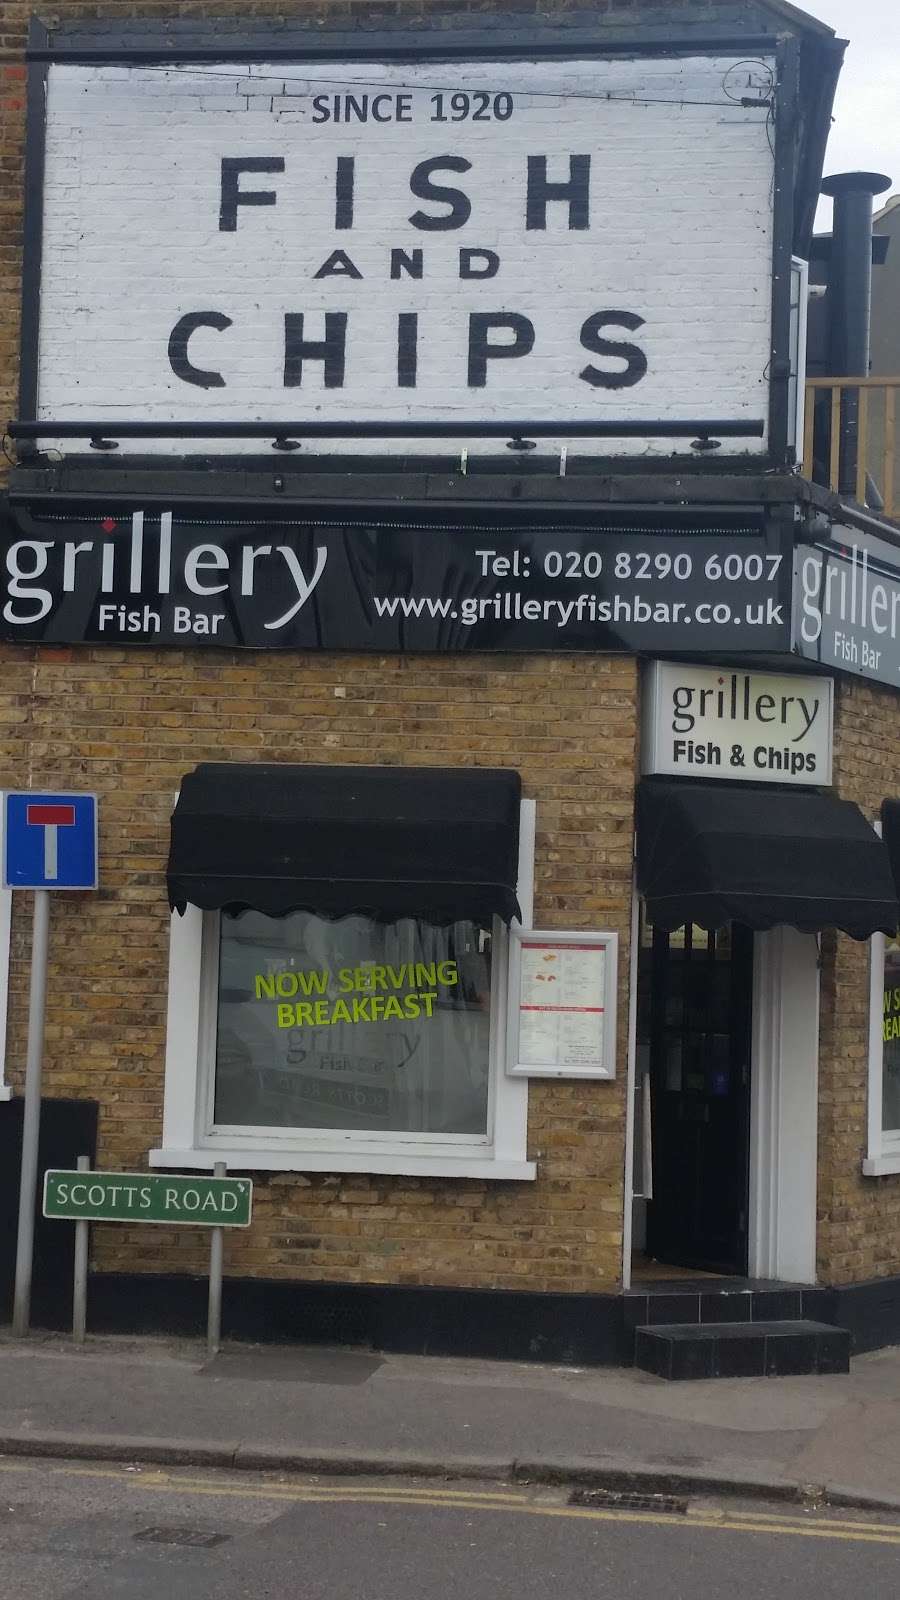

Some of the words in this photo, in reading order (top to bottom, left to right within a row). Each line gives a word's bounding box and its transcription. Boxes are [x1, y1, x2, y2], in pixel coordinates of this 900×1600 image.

[311, 95, 412, 124] SINCE
[429, 91, 514, 122] 1920
[218, 154, 591, 232] FISH
[313, 248, 500, 280] AND
[167, 311, 648, 389] CHIPS
[3, 511, 328, 630] grillery
[475, 550, 531, 577] Tel:
[543, 551, 603, 578] 020
[613, 553, 694, 580] 8290
[703, 554, 784, 581] 6007
[99, 605, 161, 632] Fish
[173, 607, 225, 634] Bar
[374, 592, 784, 627] www.grilleryfishbar.co.uk
[834, 631, 858, 664] Fish
[862, 641, 882, 670] Bar
[671, 674, 819, 742] grillery
[673, 740, 721, 765] Fish
[730, 744, 745, 767] &
[753, 746, 816, 774] Chips
[254, 969, 330, 1000] NOW
[338, 960, 458, 993] SERVING
[277, 992, 437, 1028] BREAKFAST
[56, 1184, 151, 1208] SCOTTS
[165, 1189, 238, 1212] ROAD
